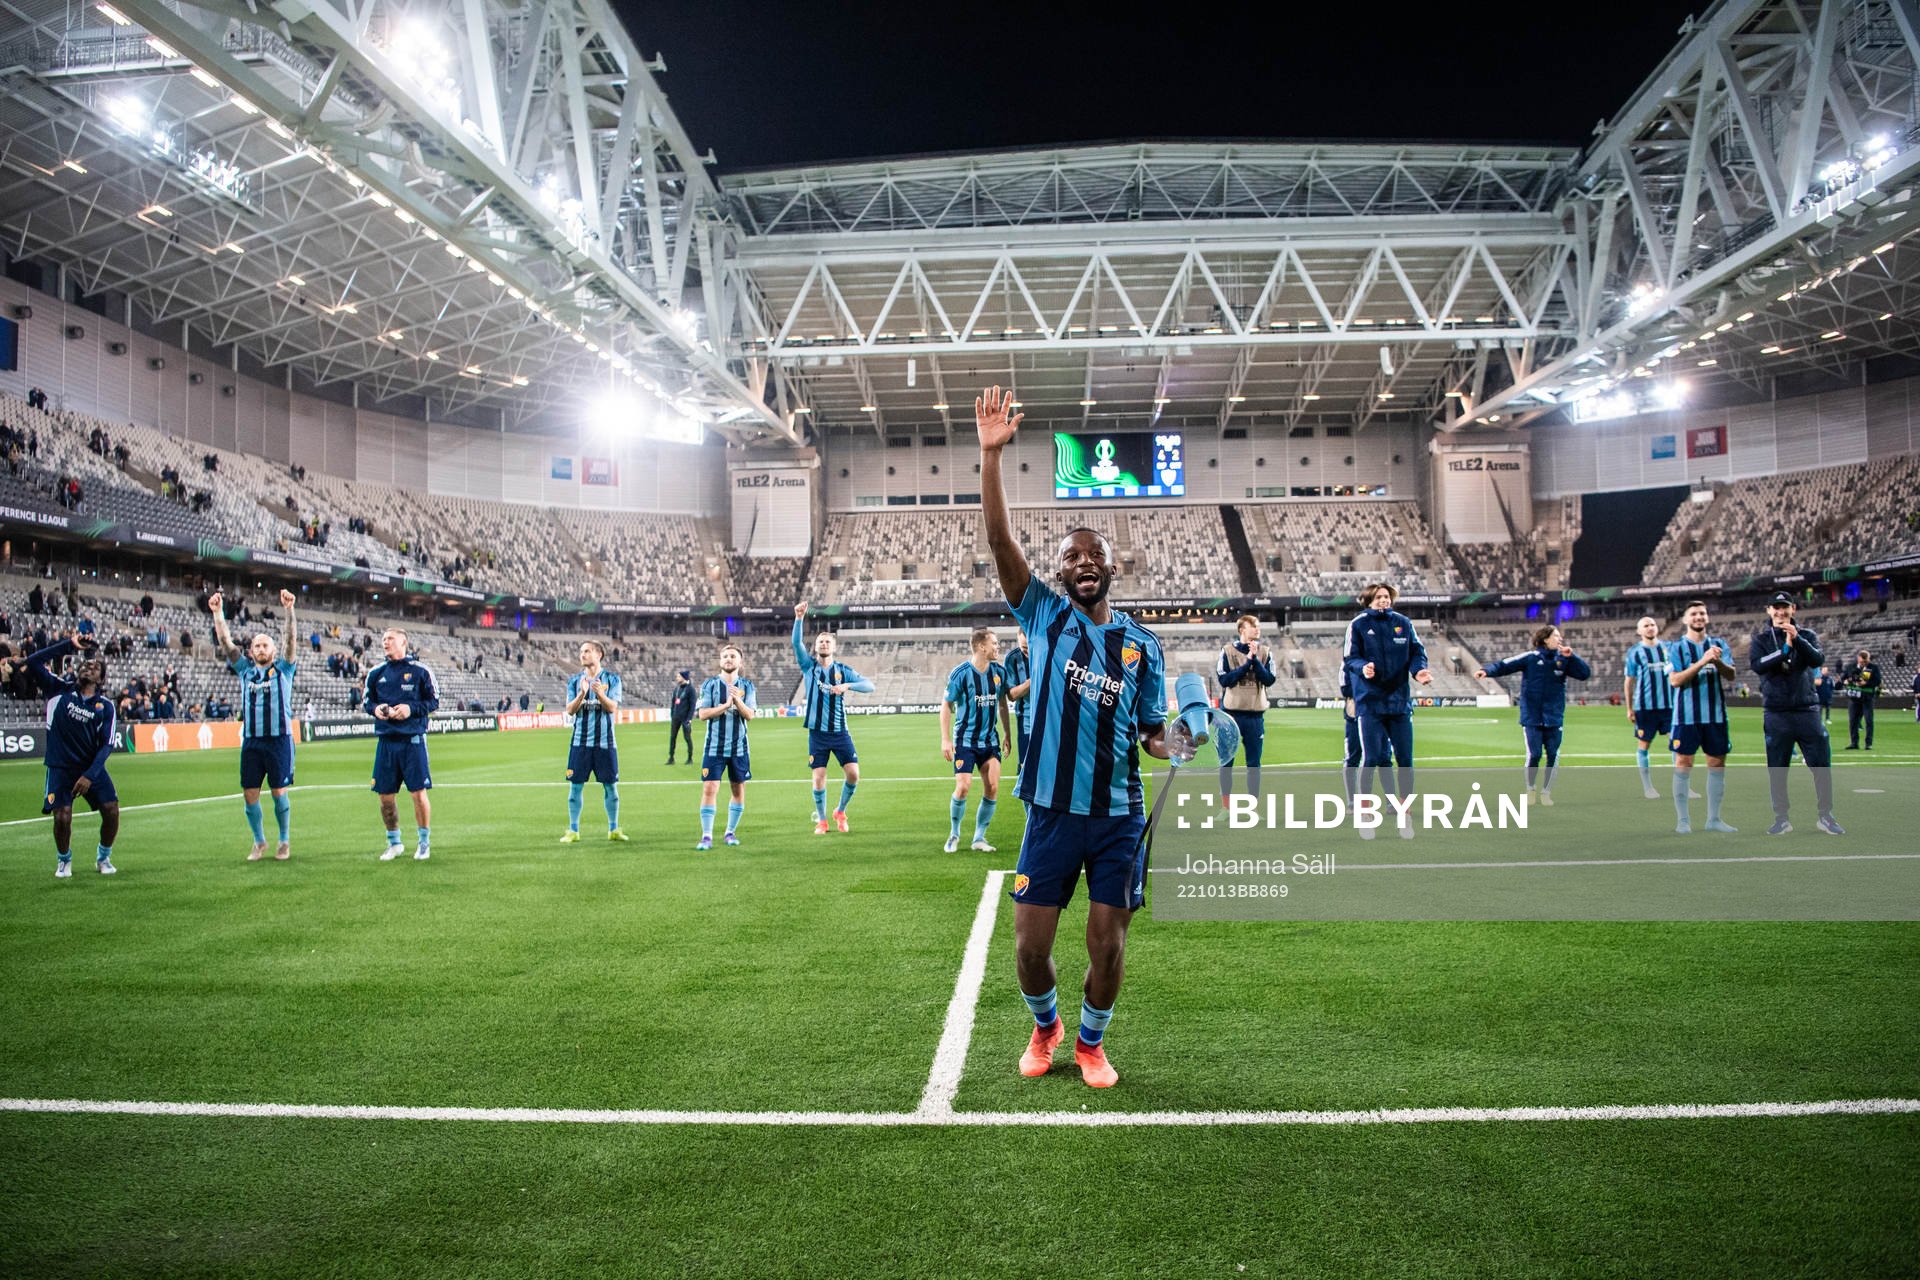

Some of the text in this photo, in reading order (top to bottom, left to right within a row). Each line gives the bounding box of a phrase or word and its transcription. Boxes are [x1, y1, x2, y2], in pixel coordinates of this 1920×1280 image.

[1448, 457, 1520, 471] TELE2 Arena
[737, 474, 805, 487] TELE2 Arena
[0, 505, 68, 528] FERENCE LEAGUE
[1064, 659, 1125, 695] Prioritet
[1069, 676, 1114, 706] Finans
[67, 702, 95, 719] Prioritet
[843, 704, 897, 715] nterprise
[1315, 698, 1346, 709] bwin
[427, 716, 464, 734] terprise
